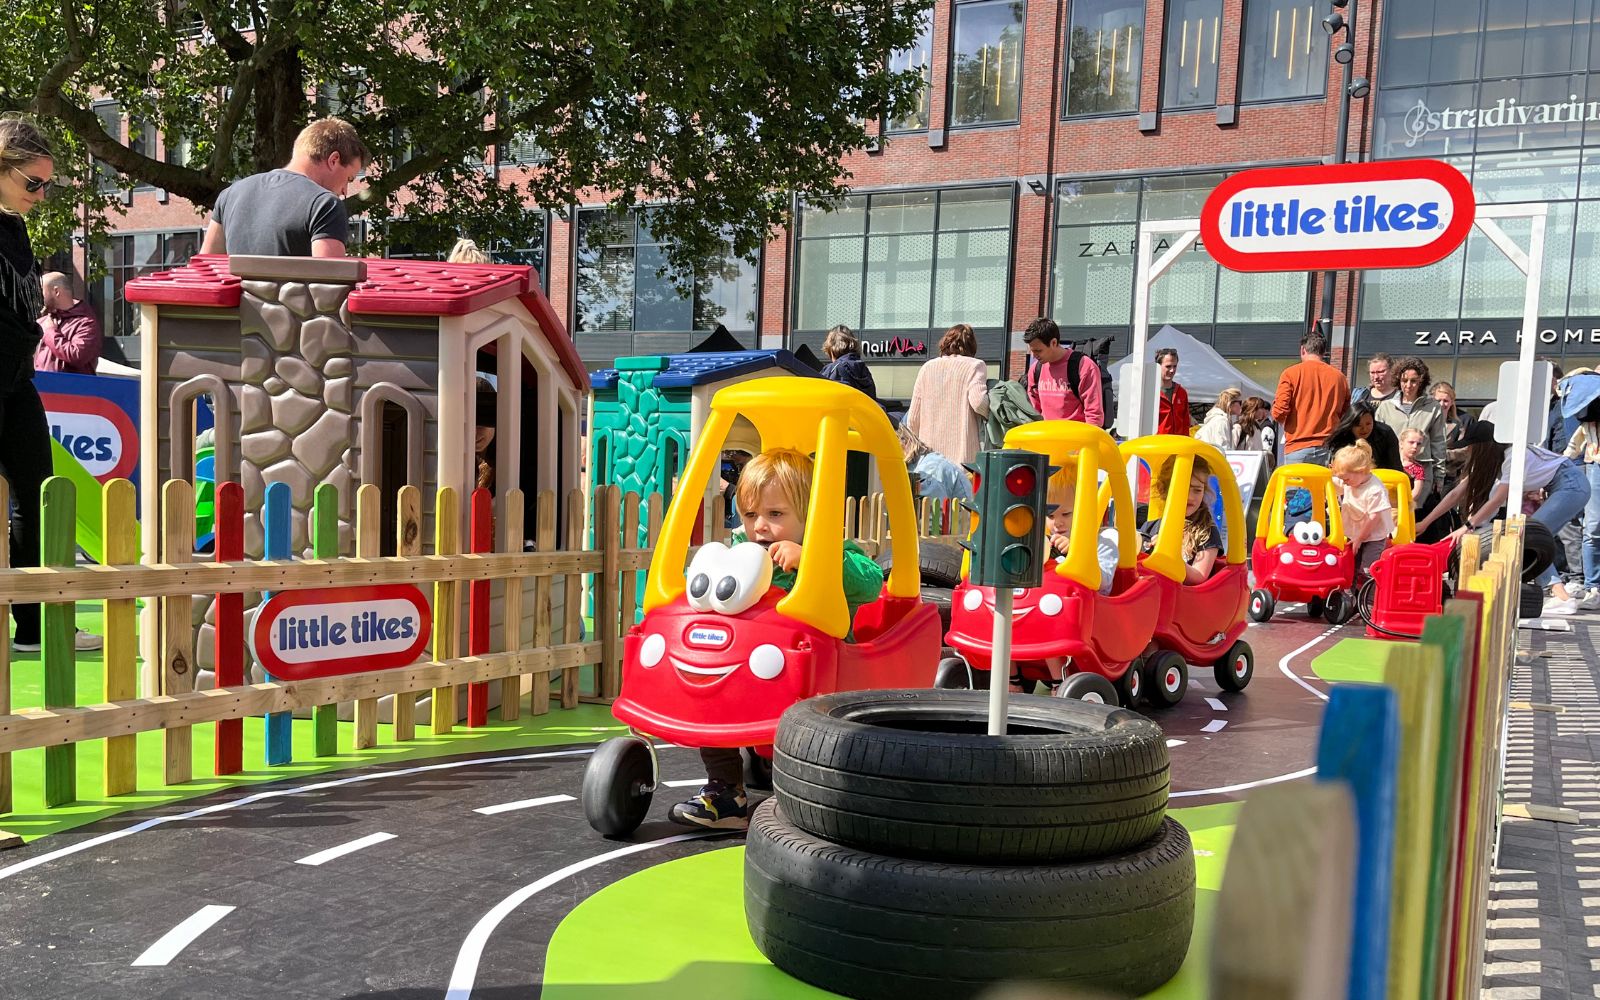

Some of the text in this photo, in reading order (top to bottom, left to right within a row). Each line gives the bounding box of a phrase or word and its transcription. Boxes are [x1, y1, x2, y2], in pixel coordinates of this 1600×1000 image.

[1427, 94, 1600, 131] stradivariu
[1230, 195, 1439, 237] little tikes
[1415, 330, 1497, 345] ZARA
[51, 425, 113, 461] kes
[279, 611, 413, 651] little tikes
[691, 632, 707, 640] little
